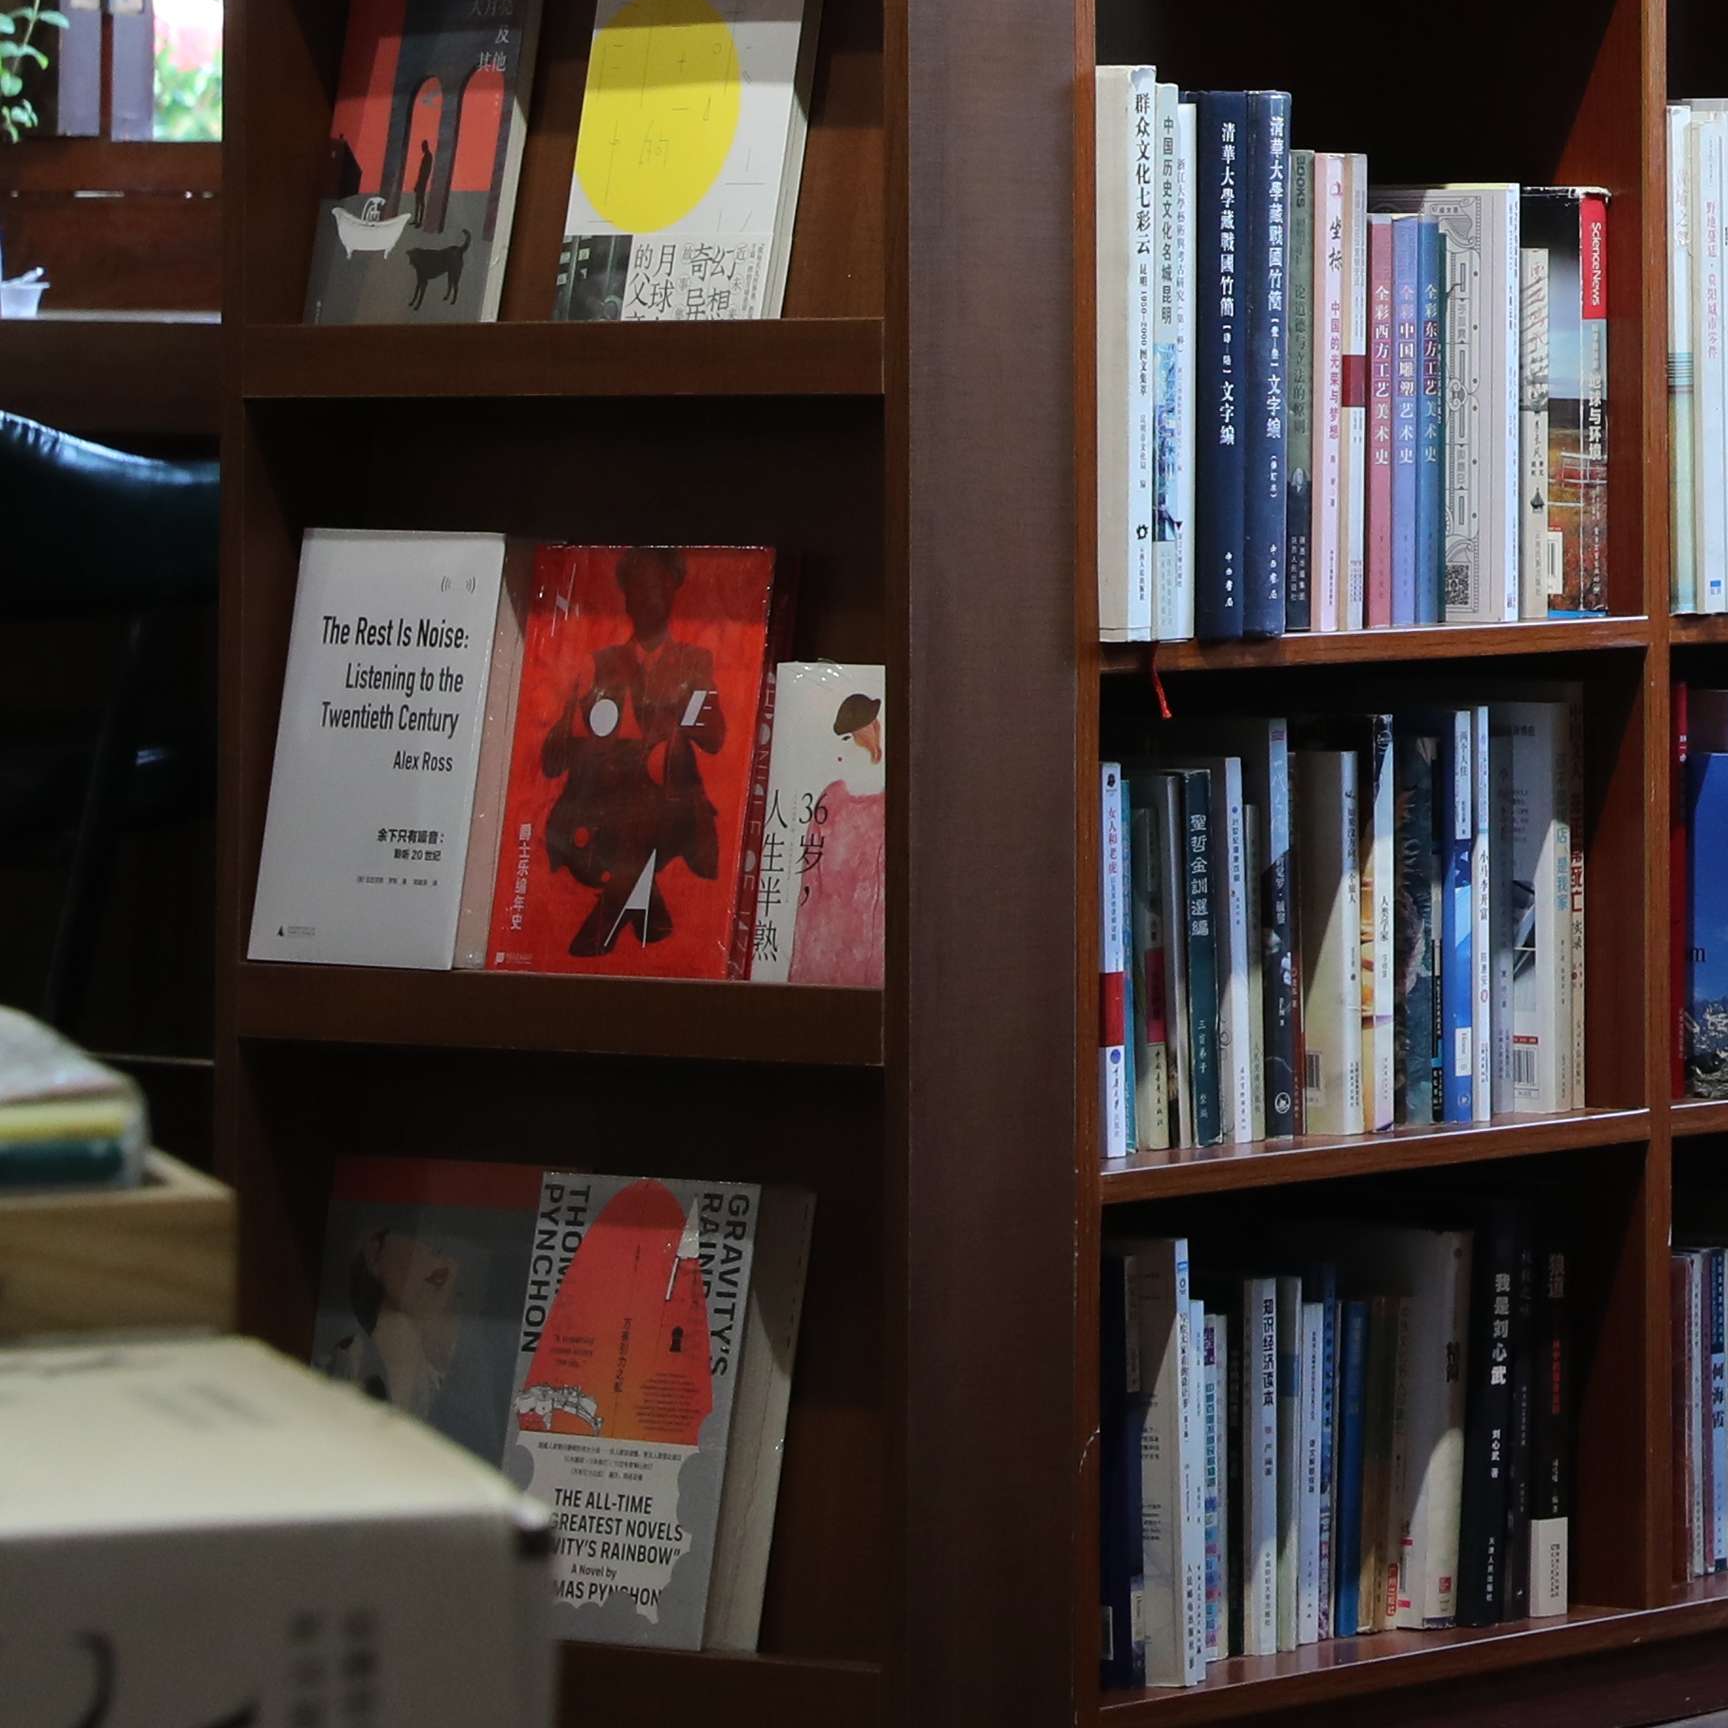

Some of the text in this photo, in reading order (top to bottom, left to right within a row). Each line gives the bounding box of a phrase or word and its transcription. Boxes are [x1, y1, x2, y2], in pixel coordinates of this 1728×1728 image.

[1134, 93, 1151, 256] 群众文化七彩云
[1375, 284, 1391, 466] 全彩西方工艺美术史
[1423, 283, 1438, 463] 全彩东方工艺美术史
[321, 616, 470, 650] The Rest Is Noise:
[344, 661, 464, 696] Listening to the
[320, 701, 459, 740] Twentieth Century
[392, 751, 454, 773] Alex Ross
[750, 788, 789, 963] 人生半熟
[519, 1182, 566, 1354] PYNCHON
[553, 1488, 654, 1516] THE ALL-TIME
[624, 1517, 684, 1543] NOVELS
[579, 1565, 605, 1579] Novel
[606, 1567, 618, 1582] by
